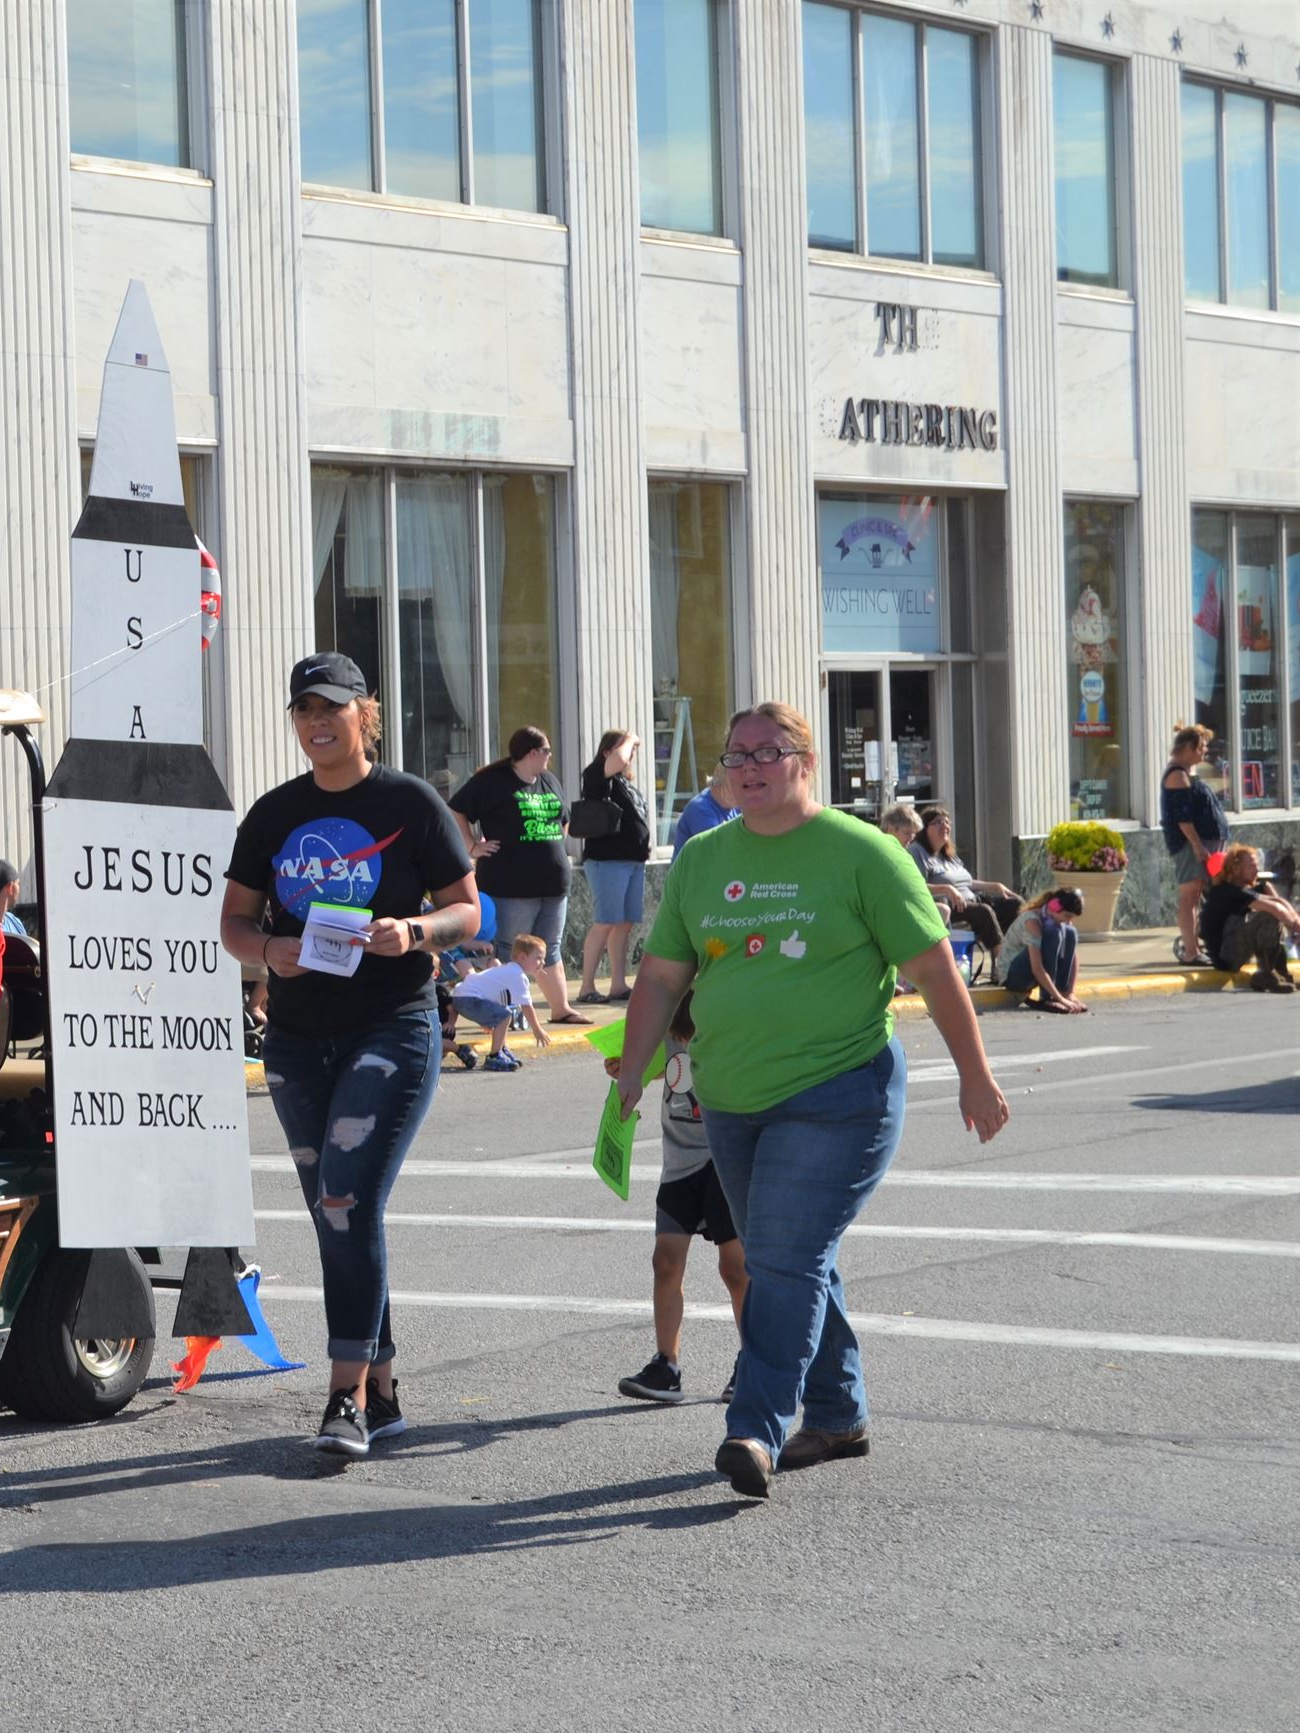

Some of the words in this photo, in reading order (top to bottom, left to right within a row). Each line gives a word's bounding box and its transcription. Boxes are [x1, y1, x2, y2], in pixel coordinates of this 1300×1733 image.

[838, 397, 998, 451] ATHERING
[822, 587, 888, 615] WISHING
[892, 588, 932, 615] WELL
[74, 846, 213, 897] JESUS
[280, 856, 374, 882] NASA
[751, 882, 799, 890] American
[750, 890, 768, 899] Red
[770, 890, 797, 899] Cross
[67, 934, 153, 972] LOVES
[164, 939, 219, 974] YOU
[63, 1013, 98, 1048] TO
[103, 1014, 154, 1050] THE
[161, 1015, 234, 1052] MOON
[70, 1091, 125, 1127] AND
